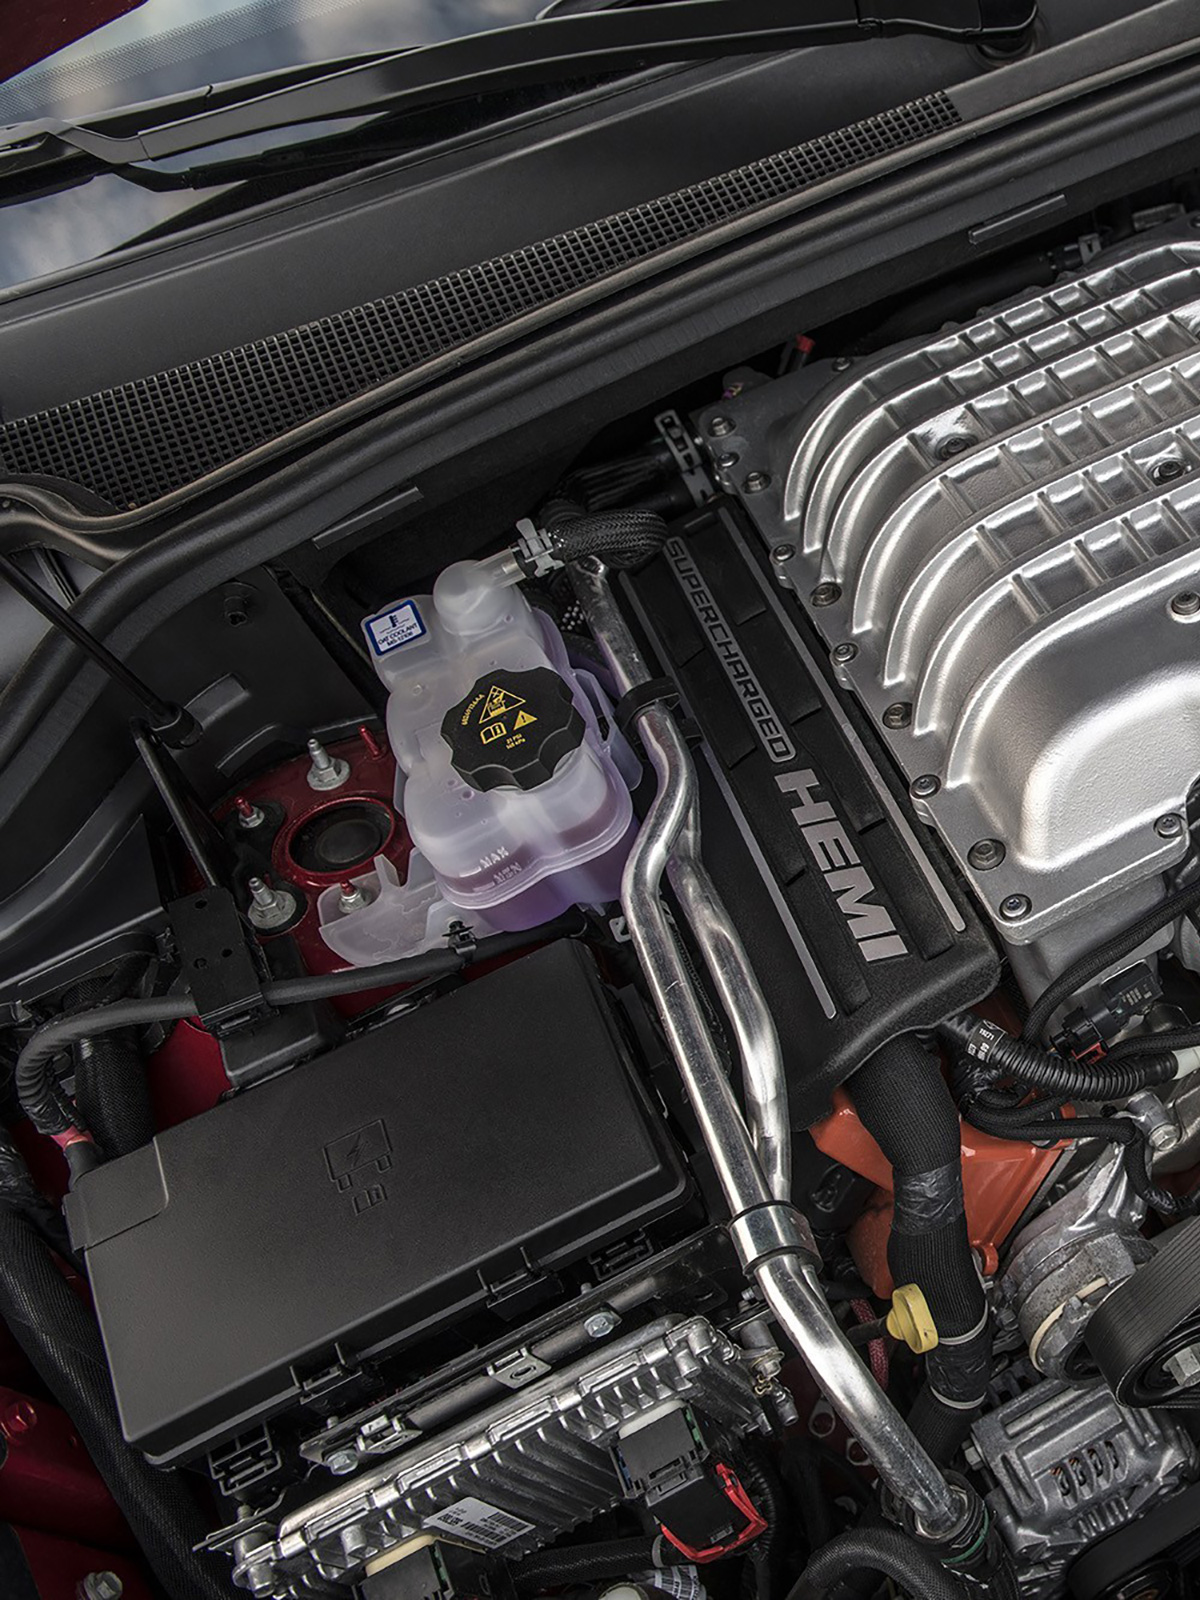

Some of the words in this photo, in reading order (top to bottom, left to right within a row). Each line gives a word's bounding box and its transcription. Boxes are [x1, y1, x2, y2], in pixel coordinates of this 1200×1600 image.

[389, 622, 418, 639] COOLANT
[669, 539, 791, 758] SUPERCHARGED
[480, 846, 509, 869] MAX
[774, 768, 908, 962] HEMI
